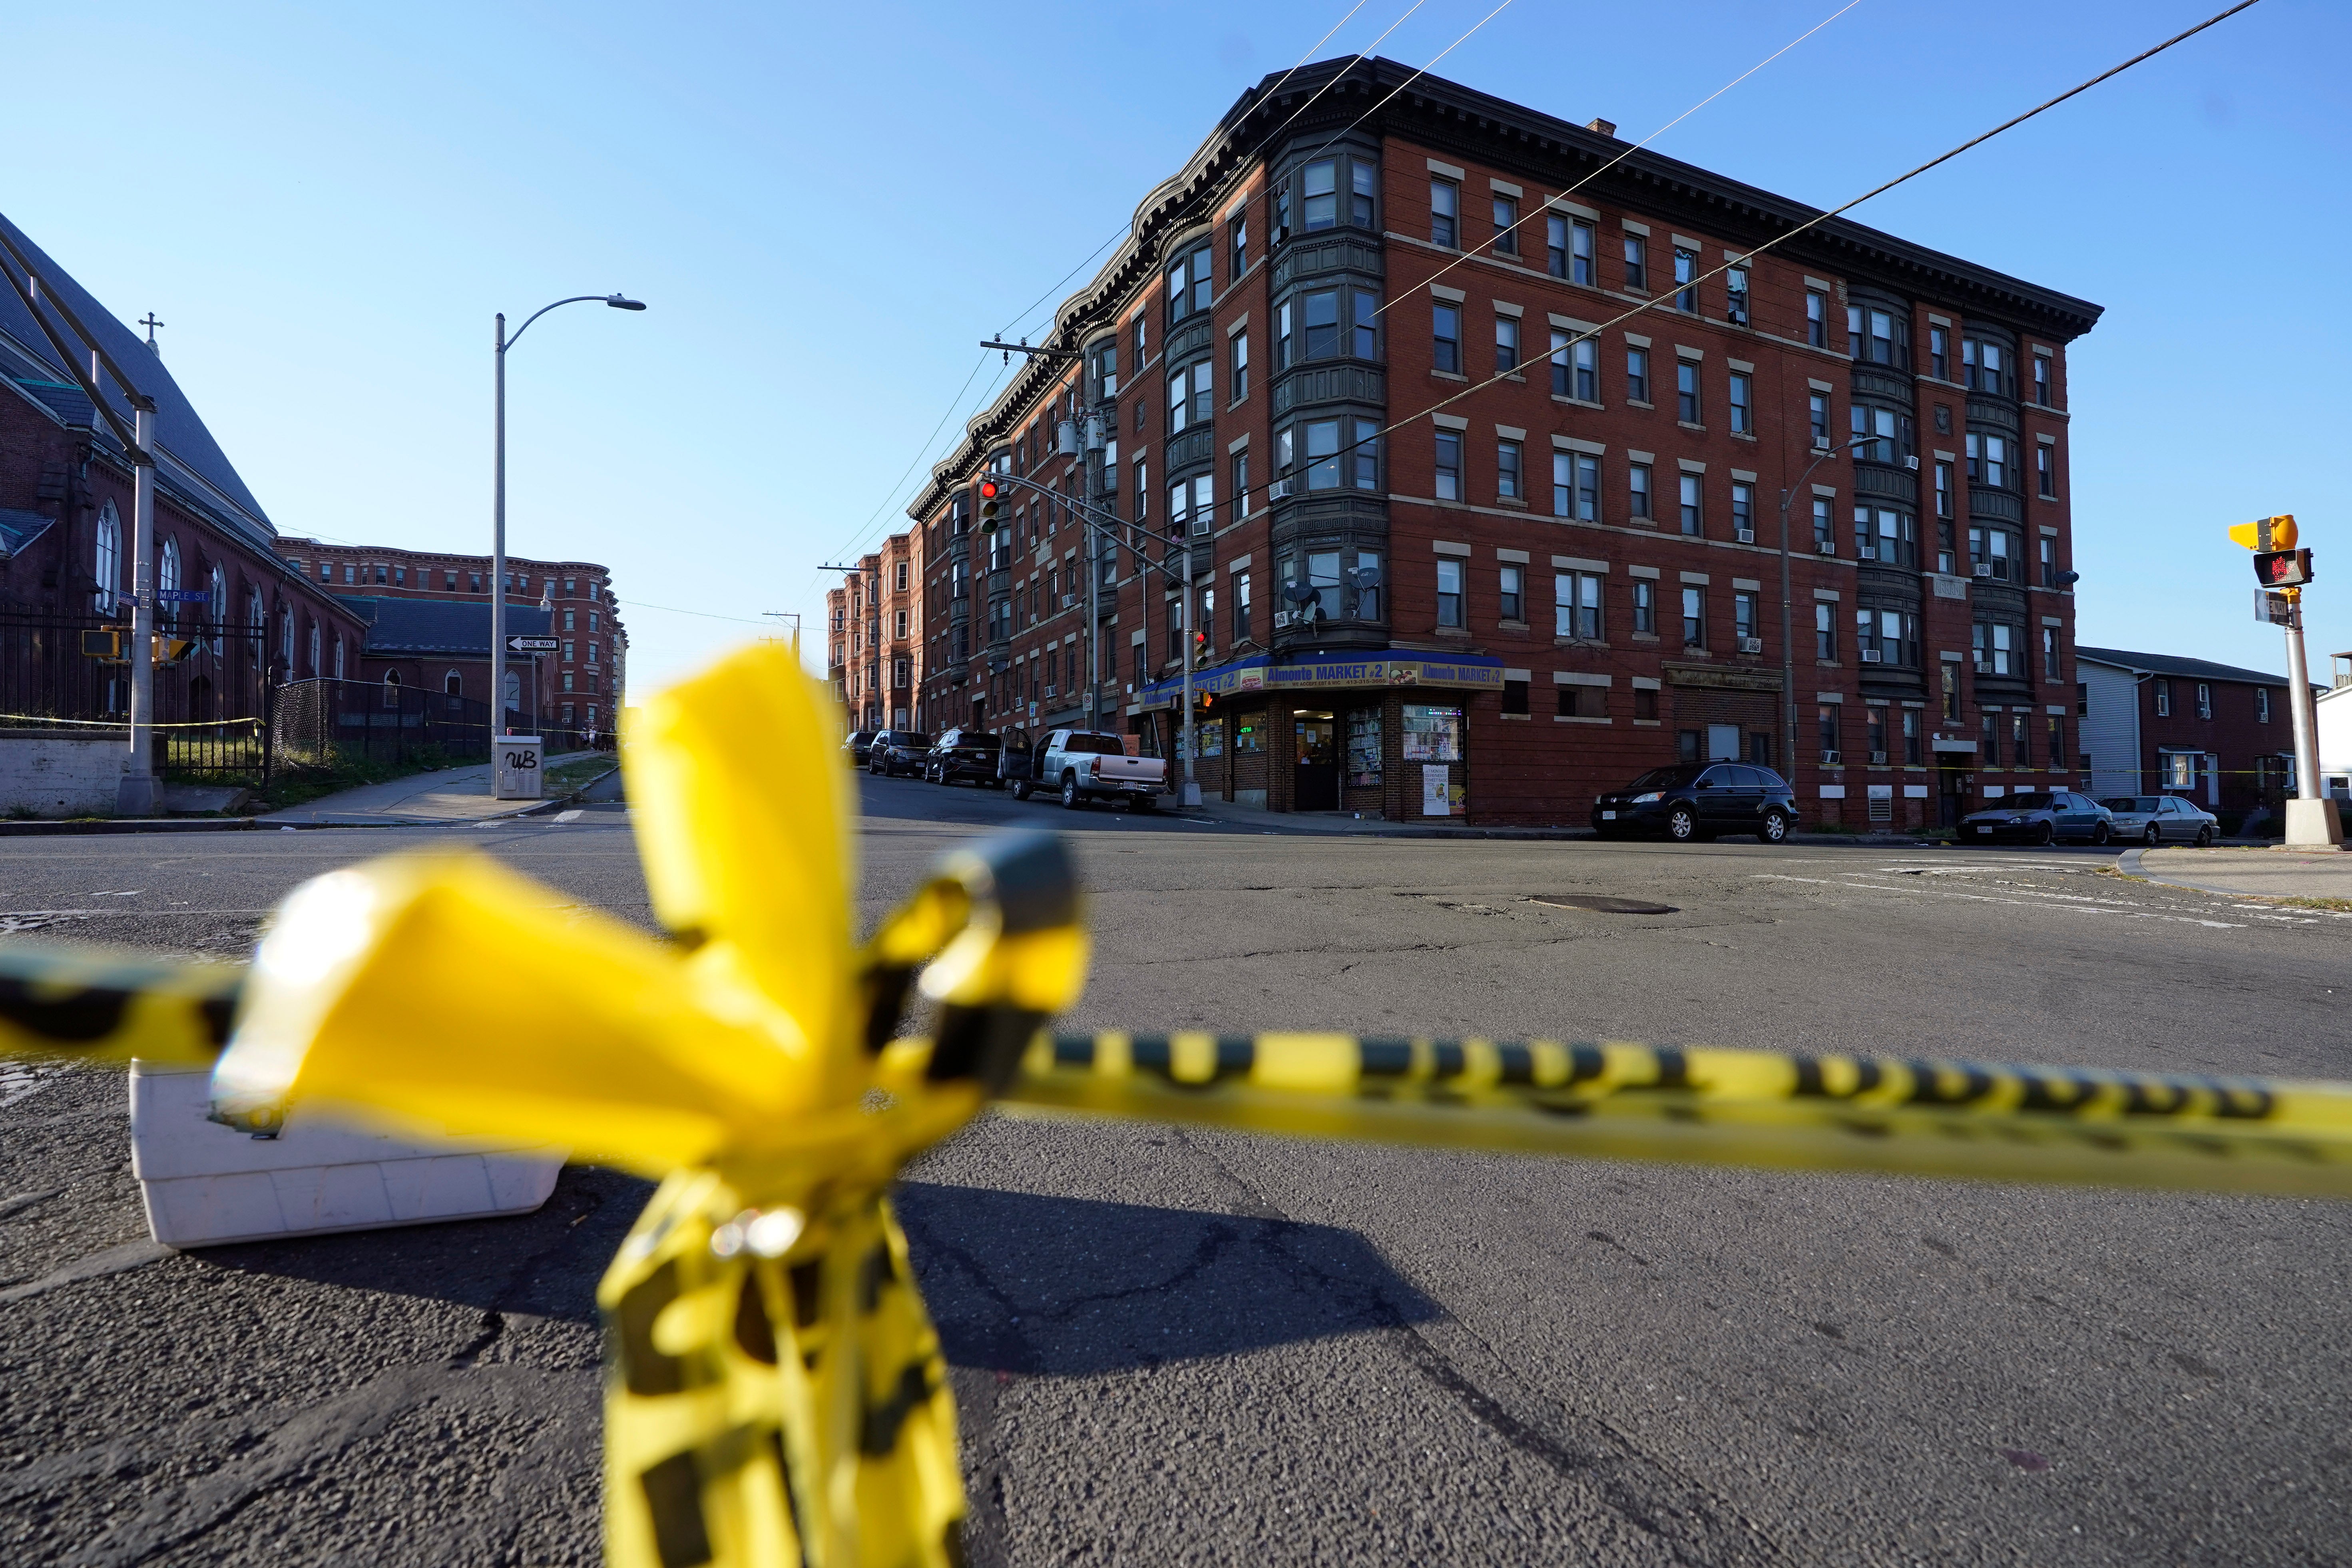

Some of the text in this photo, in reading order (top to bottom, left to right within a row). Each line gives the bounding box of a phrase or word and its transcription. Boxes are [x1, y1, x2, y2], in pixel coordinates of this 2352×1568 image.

[160, 591, 189, 600] MAPLE
[1936, 582, 1964, 596] ARMAND
[2275, 602, 2285, 614] WAY
[1267, 664, 1382, 681] Almonte MARKET #2
[1458, 667, 1491, 682] MARKET
[1492, 670, 1500, 683] #2
[1224, 673, 1235, 689] #2
